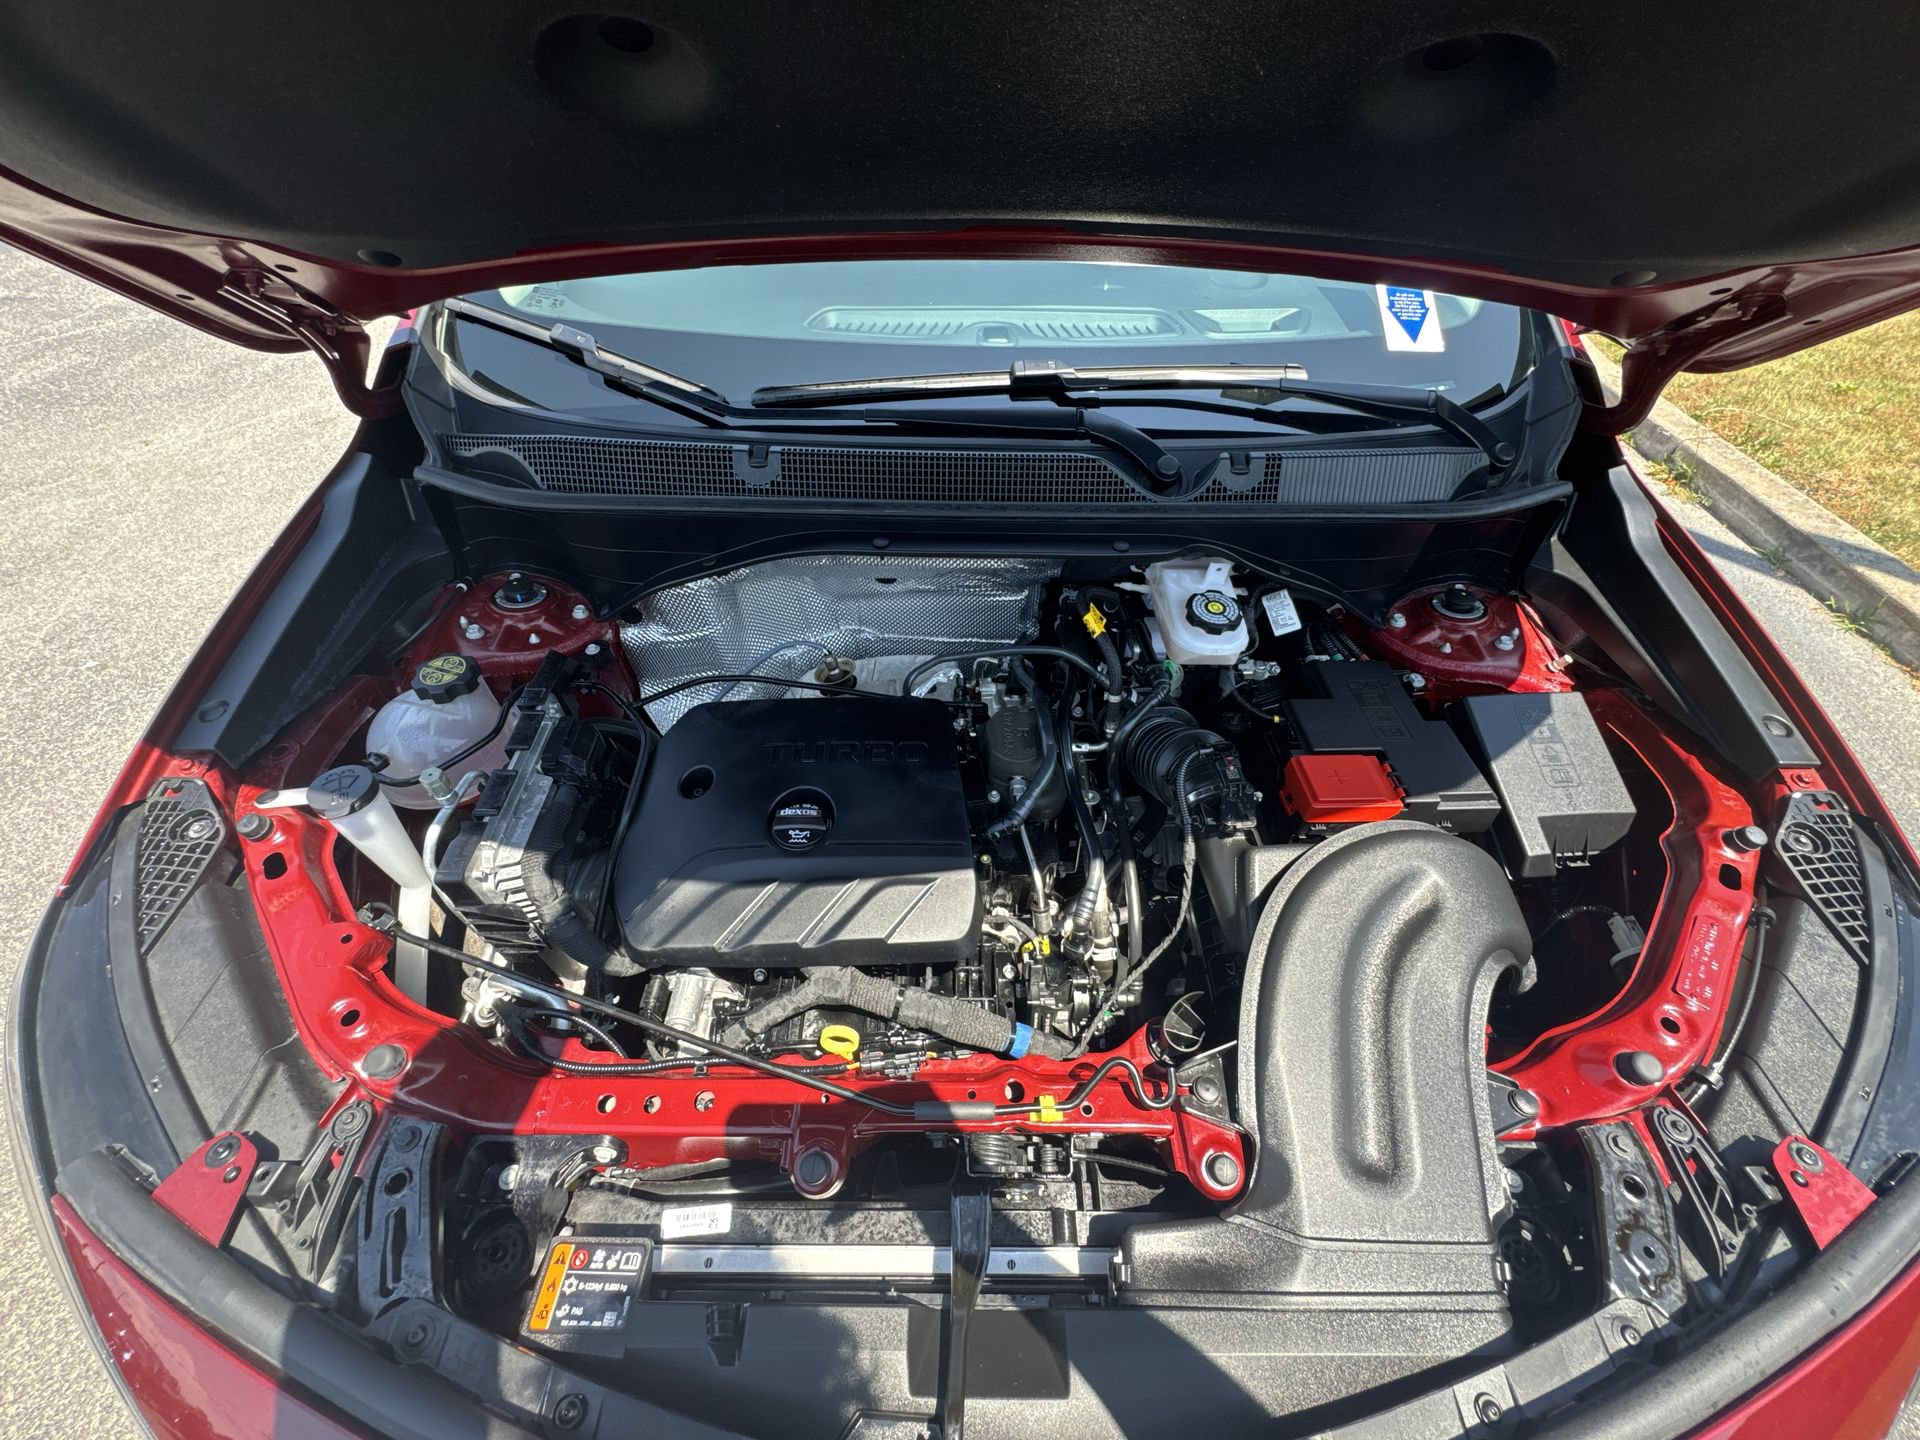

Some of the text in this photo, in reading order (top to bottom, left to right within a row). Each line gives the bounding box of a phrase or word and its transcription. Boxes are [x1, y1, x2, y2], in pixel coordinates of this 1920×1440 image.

[762, 740, 929, 768] TURBO
[780, 807, 818, 816] dexos
[570, 1306, 584, 1316] PAG
